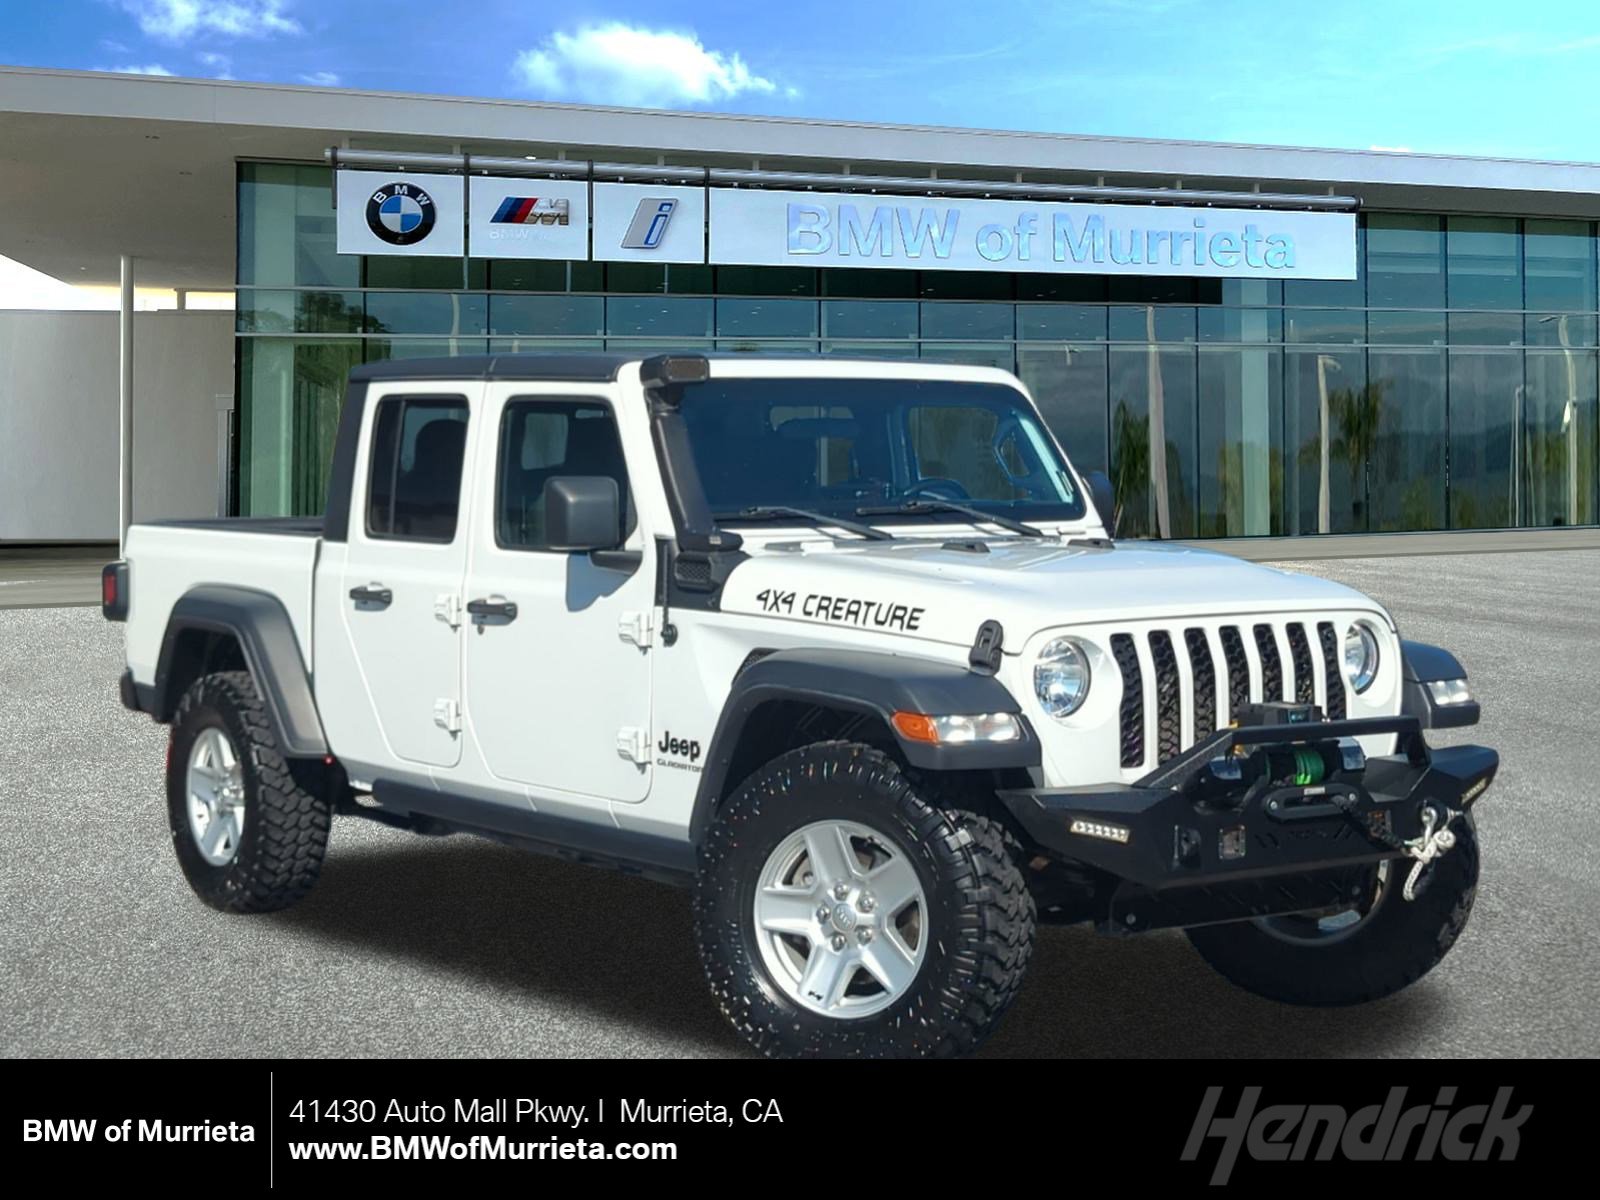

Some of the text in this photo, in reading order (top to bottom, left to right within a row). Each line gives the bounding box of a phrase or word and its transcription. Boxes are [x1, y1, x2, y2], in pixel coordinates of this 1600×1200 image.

[373, 185, 431, 206] BMW
[787, 203, 1296, 269] BMW of Murrieta
[756, 588, 926, 631] 4X4 CREATURE
[658, 730, 701, 763] Jeep
